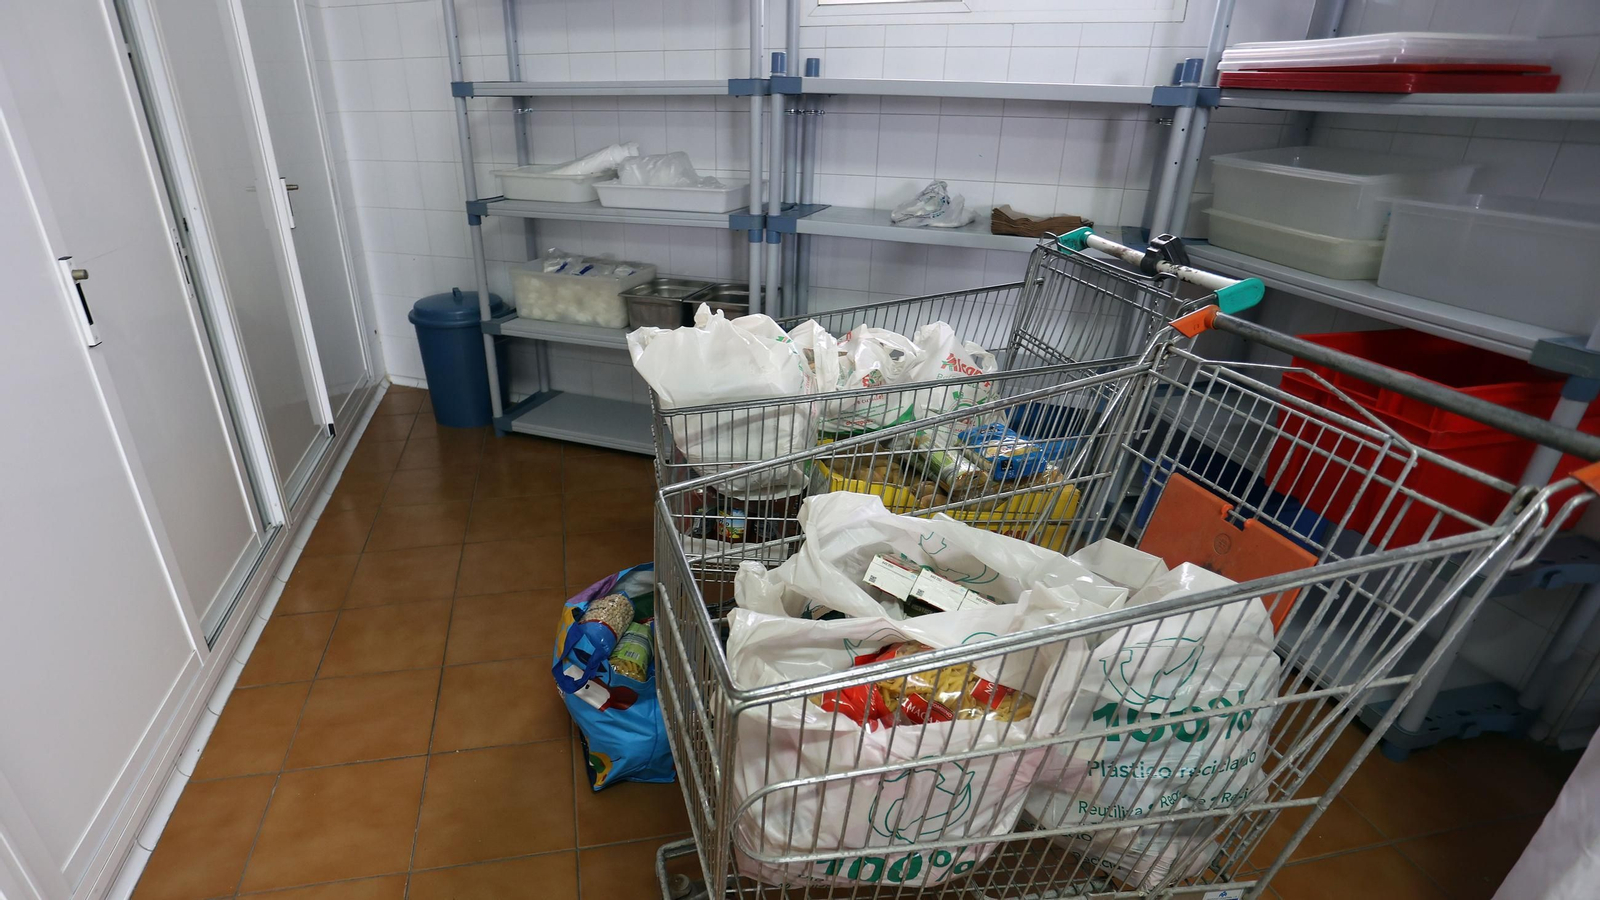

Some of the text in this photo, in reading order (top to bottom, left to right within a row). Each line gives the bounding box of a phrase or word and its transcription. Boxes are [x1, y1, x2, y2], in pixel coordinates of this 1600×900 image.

[1092, 689, 1253, 743] 100%
[1087, 759, 1172, 779] Plástico
[816, 848, 974, 883] 100%
